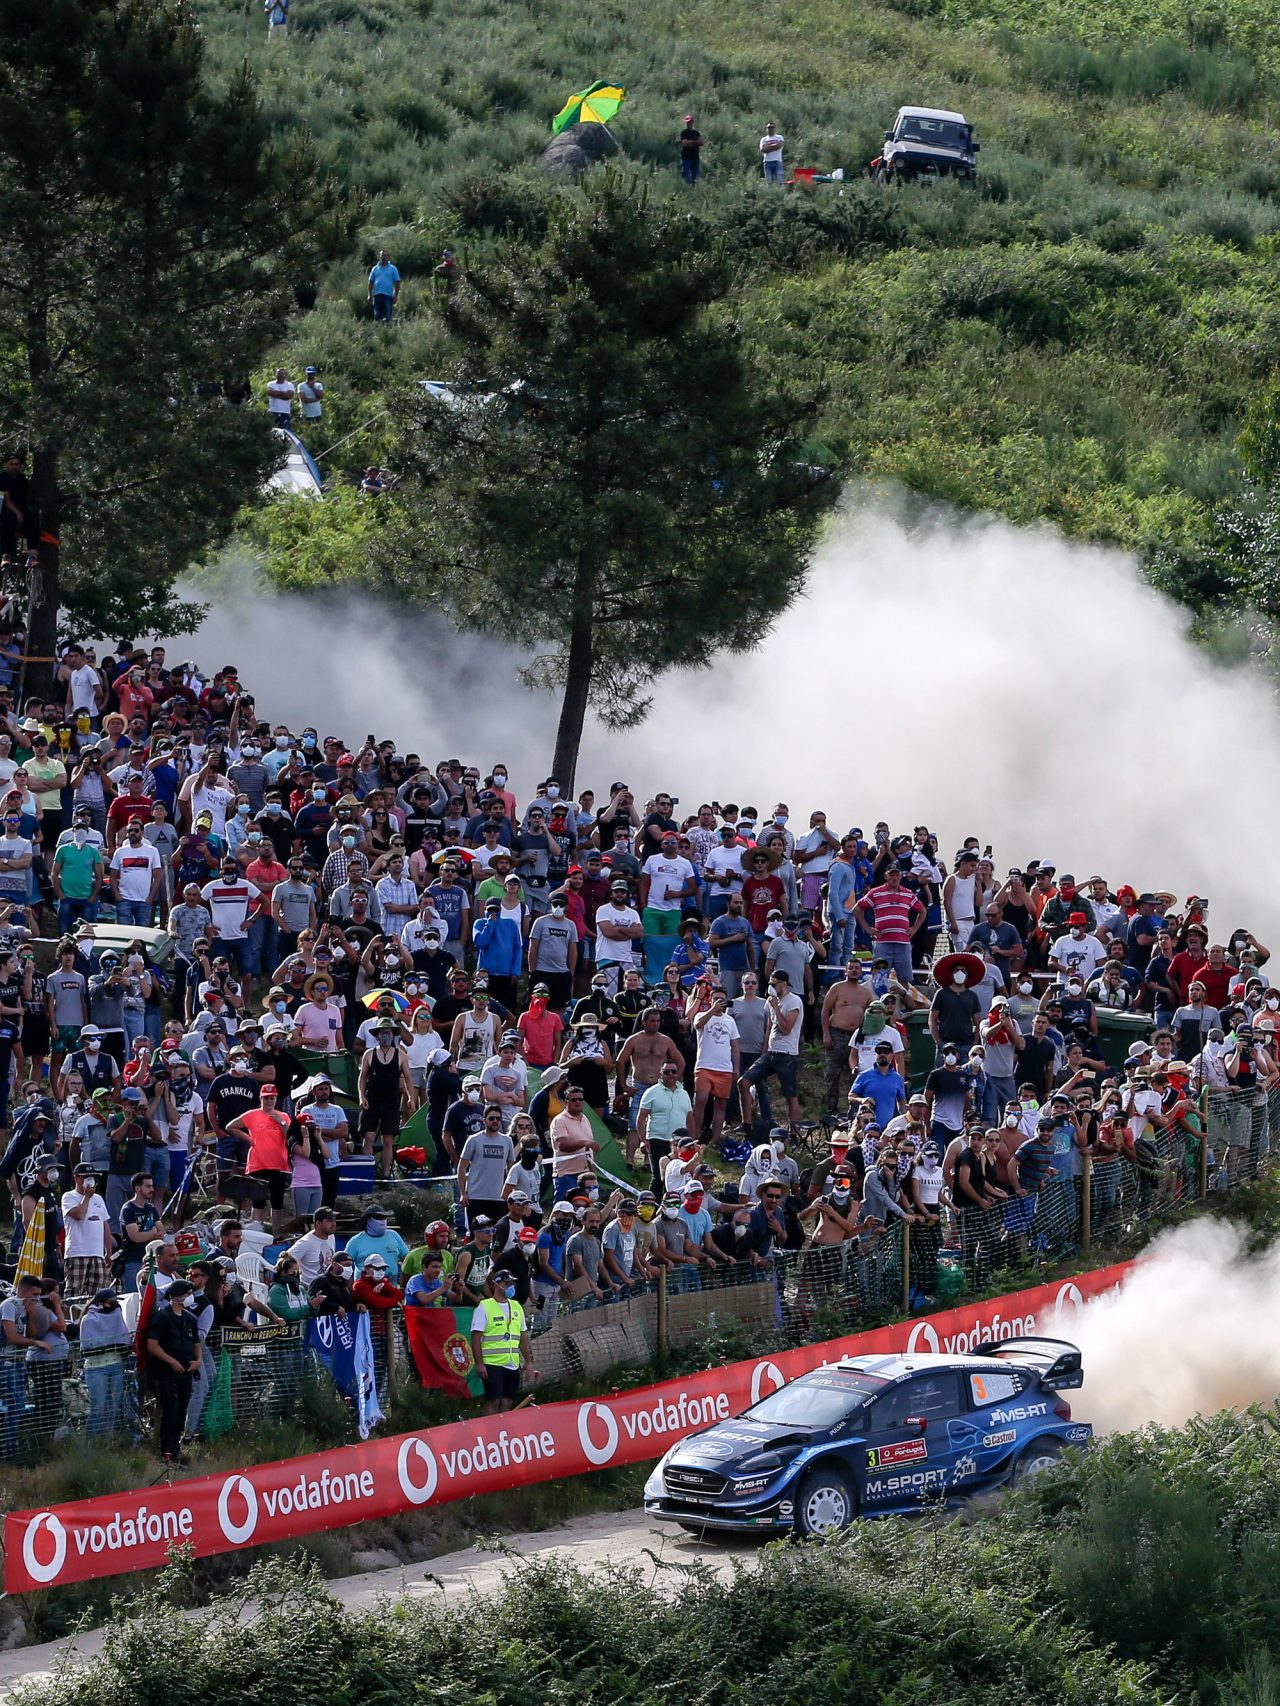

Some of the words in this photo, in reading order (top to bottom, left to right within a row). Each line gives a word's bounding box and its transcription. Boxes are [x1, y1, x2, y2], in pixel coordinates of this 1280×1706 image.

[219, 1085, 254, 1099] FRANKLIN
[944, 1314, 1036, 1354] vodafone
[972, 1375, 988, 1399] 3
[621, 1392, 730, 1439] vodafone
[991, 1431, 1015, 1445] Castrol
[441, 1429, 556, 1479] vodafone
[868, 1450, 876, 1467] 3
[894, 1445, 924, 1457] Portugal
[262, 1468, 375, 1518] vodafone
[866, 1468, 947, 1495] M-SPORT
[866, 1488, 915, 1501] EVALUATION
[73, 1505, 194, 1556] vodafone
